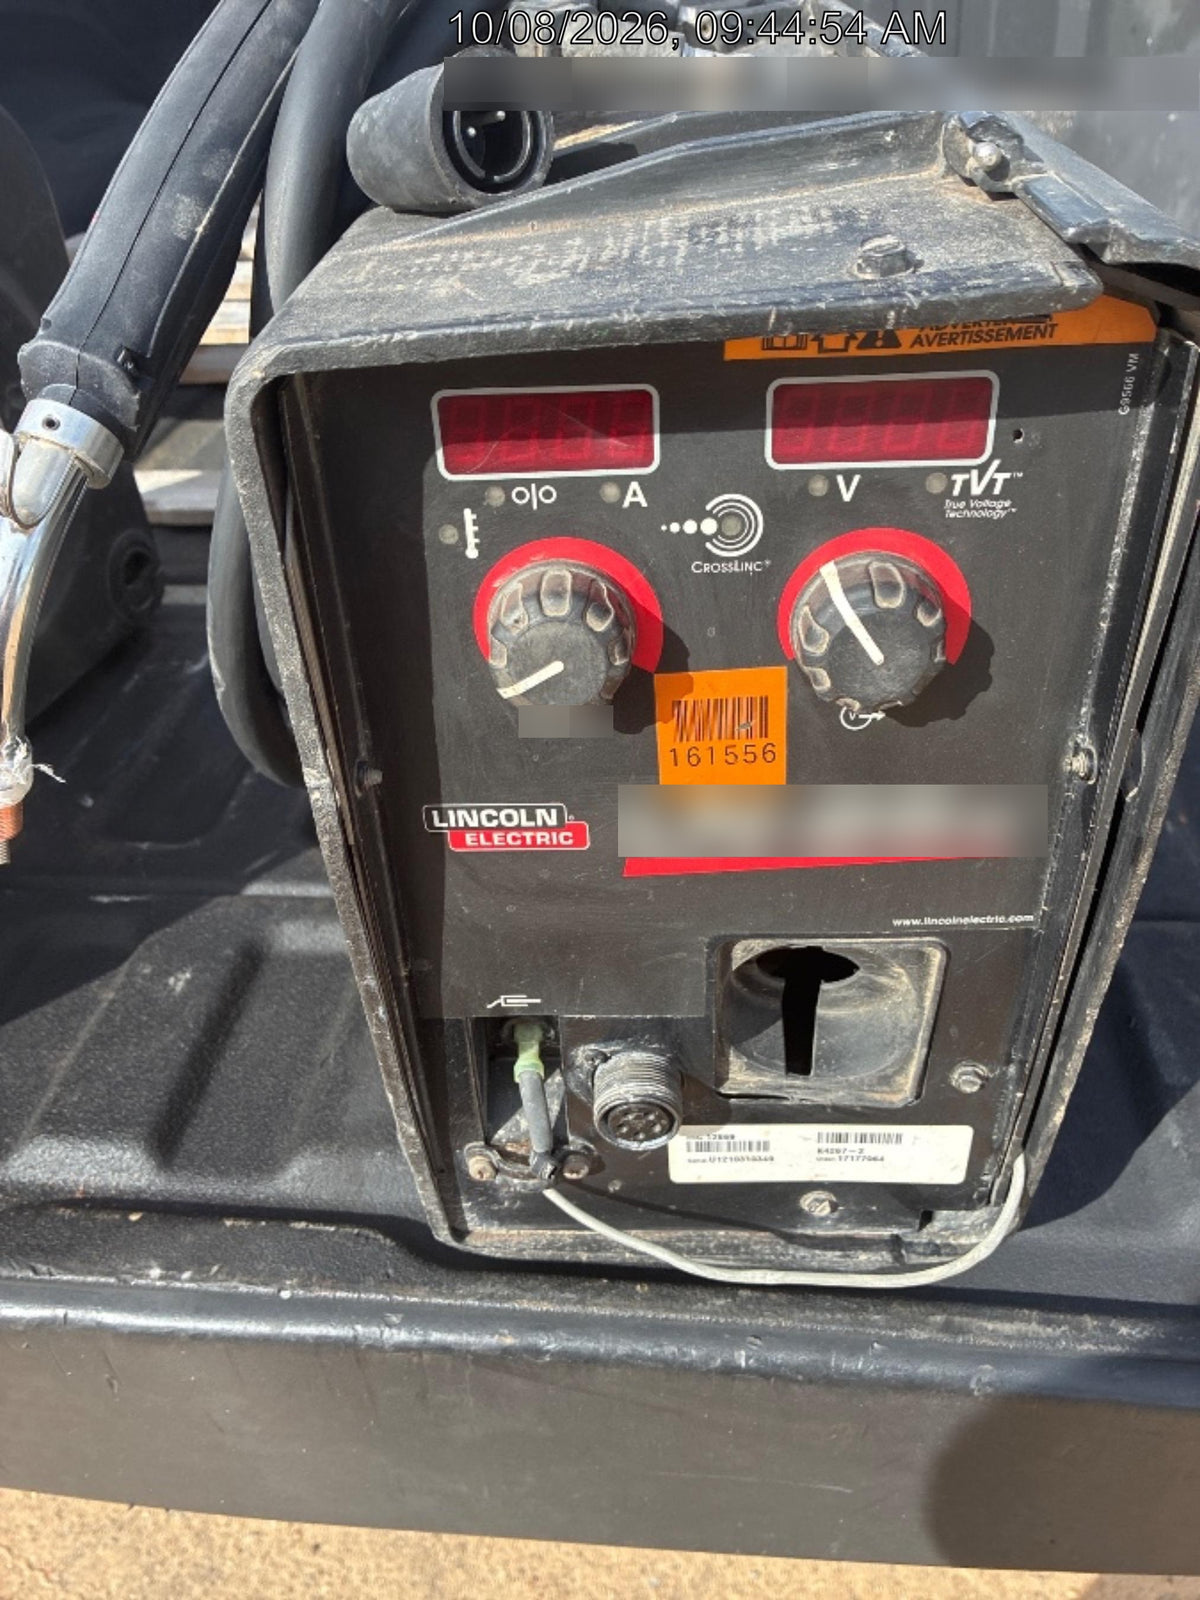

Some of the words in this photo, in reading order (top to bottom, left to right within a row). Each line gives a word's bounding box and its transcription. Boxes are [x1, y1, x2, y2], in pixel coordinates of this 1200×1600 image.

[909, 322, 1059, 349] AVERTISSEMENT
[622, 480, 649, 509] A
[835, 473, 862, 503] V
[969, 498, 1013, 511] Voltage
[669, 742, 777, 768] 161556
[431, 807, 558, 828] LINCOLN
[464, 831, 575, 847] ELECTRIC
[891, 914, 1035, 927] www.lincolnelectric.com
